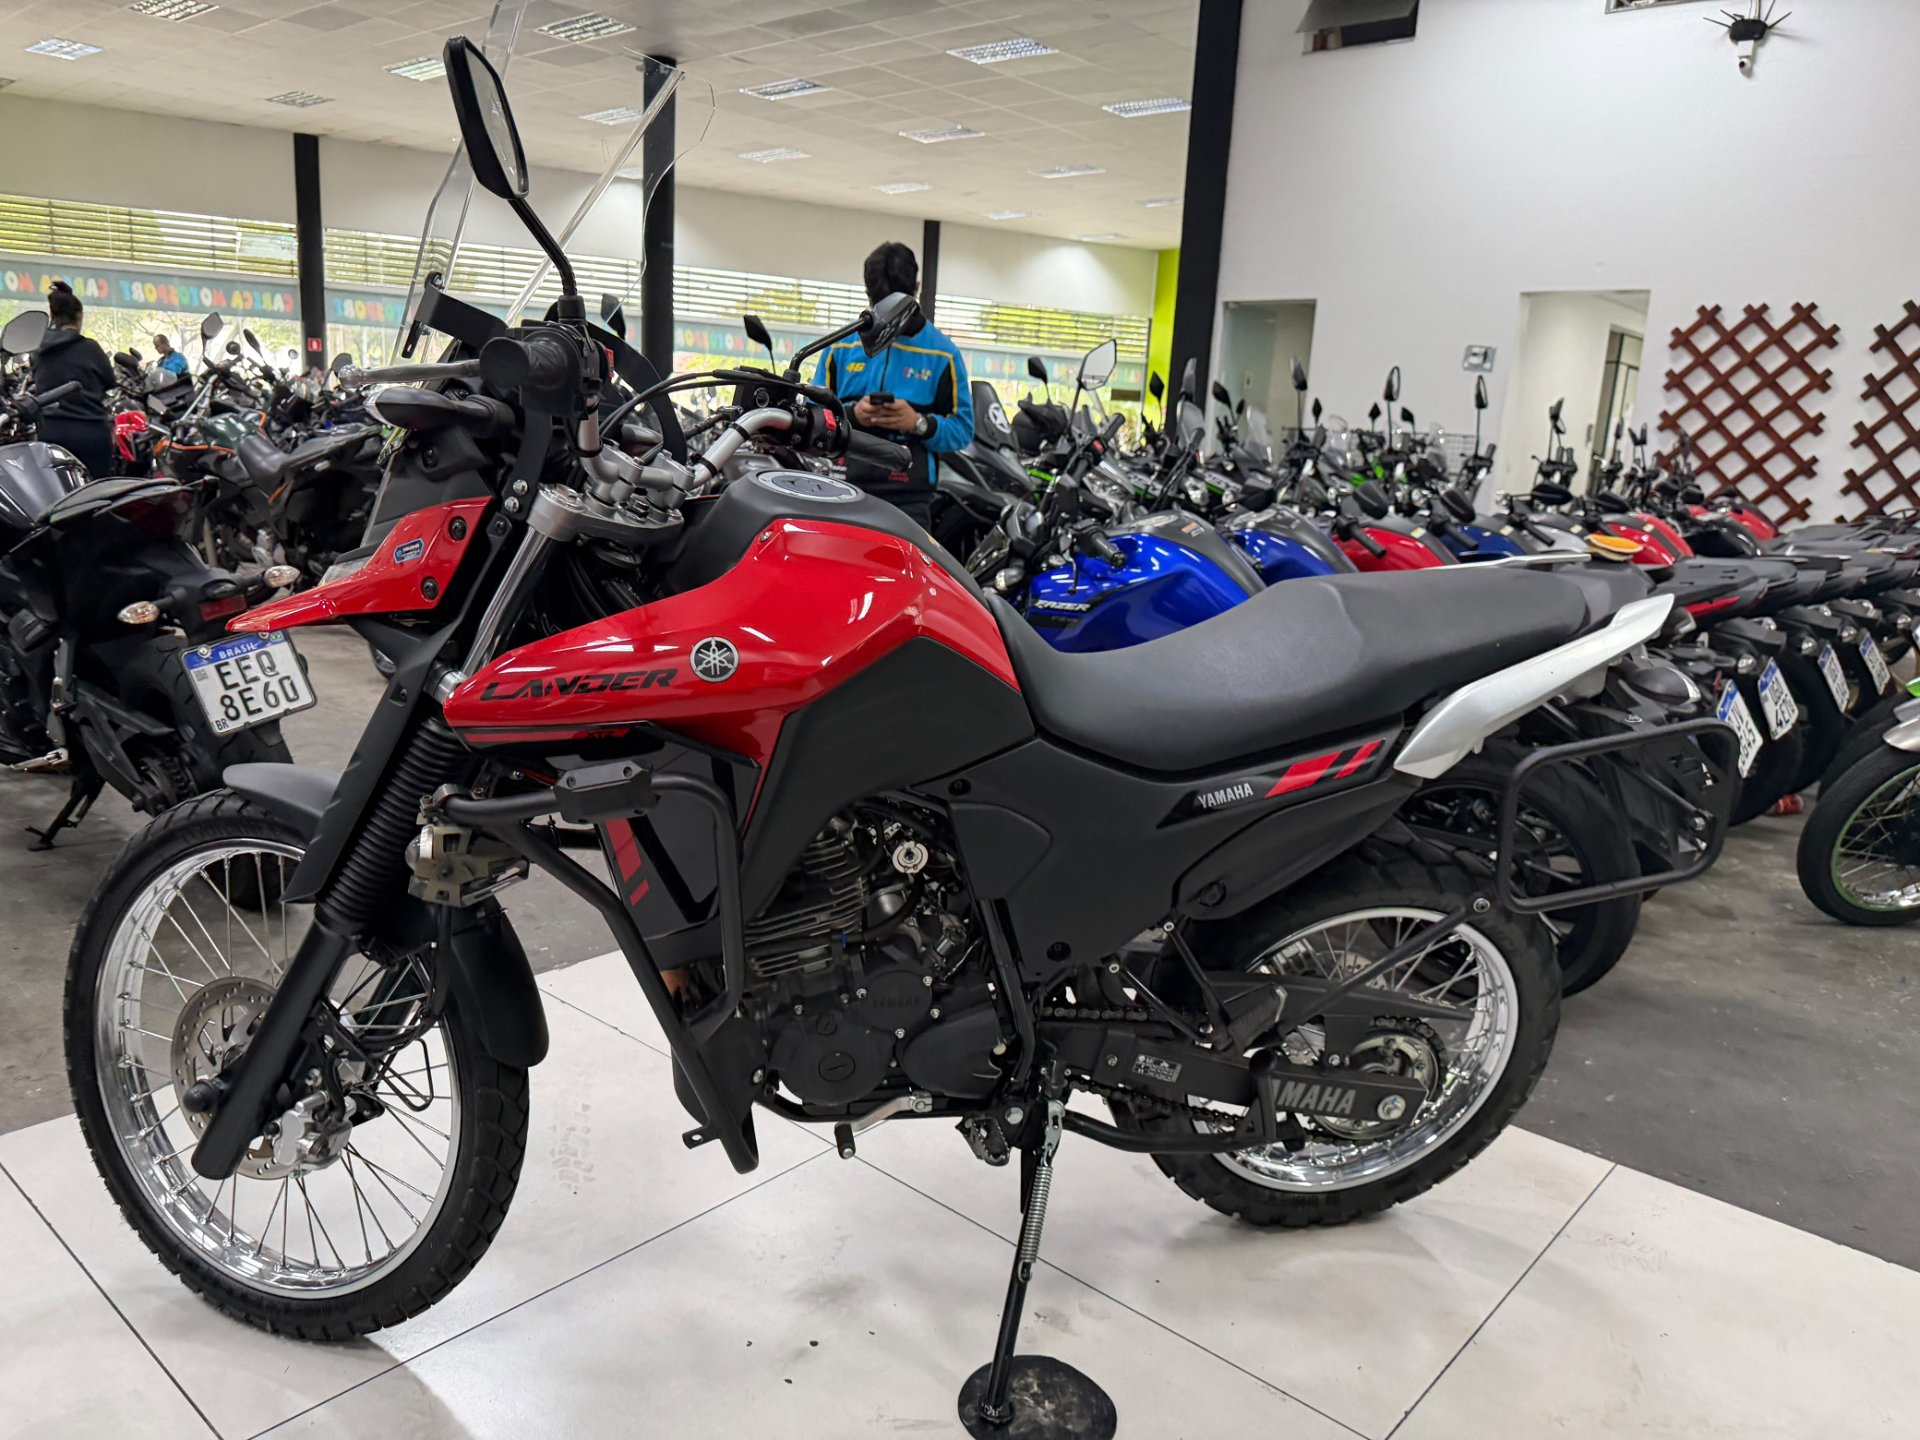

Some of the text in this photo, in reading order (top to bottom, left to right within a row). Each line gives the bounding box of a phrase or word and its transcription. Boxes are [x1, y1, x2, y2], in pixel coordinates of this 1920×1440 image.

[846, 362, 865, 373] 46
[218, 643, 259, 659] BRASIL
[214, 650, 279, 691] EEQ
[220, 675, 300, 721] 8E60
[480, 668, 679, 701] LANDER
[215, 718, 229, 731] BR
[1196, 782, 1254, 809] YAMAHA
